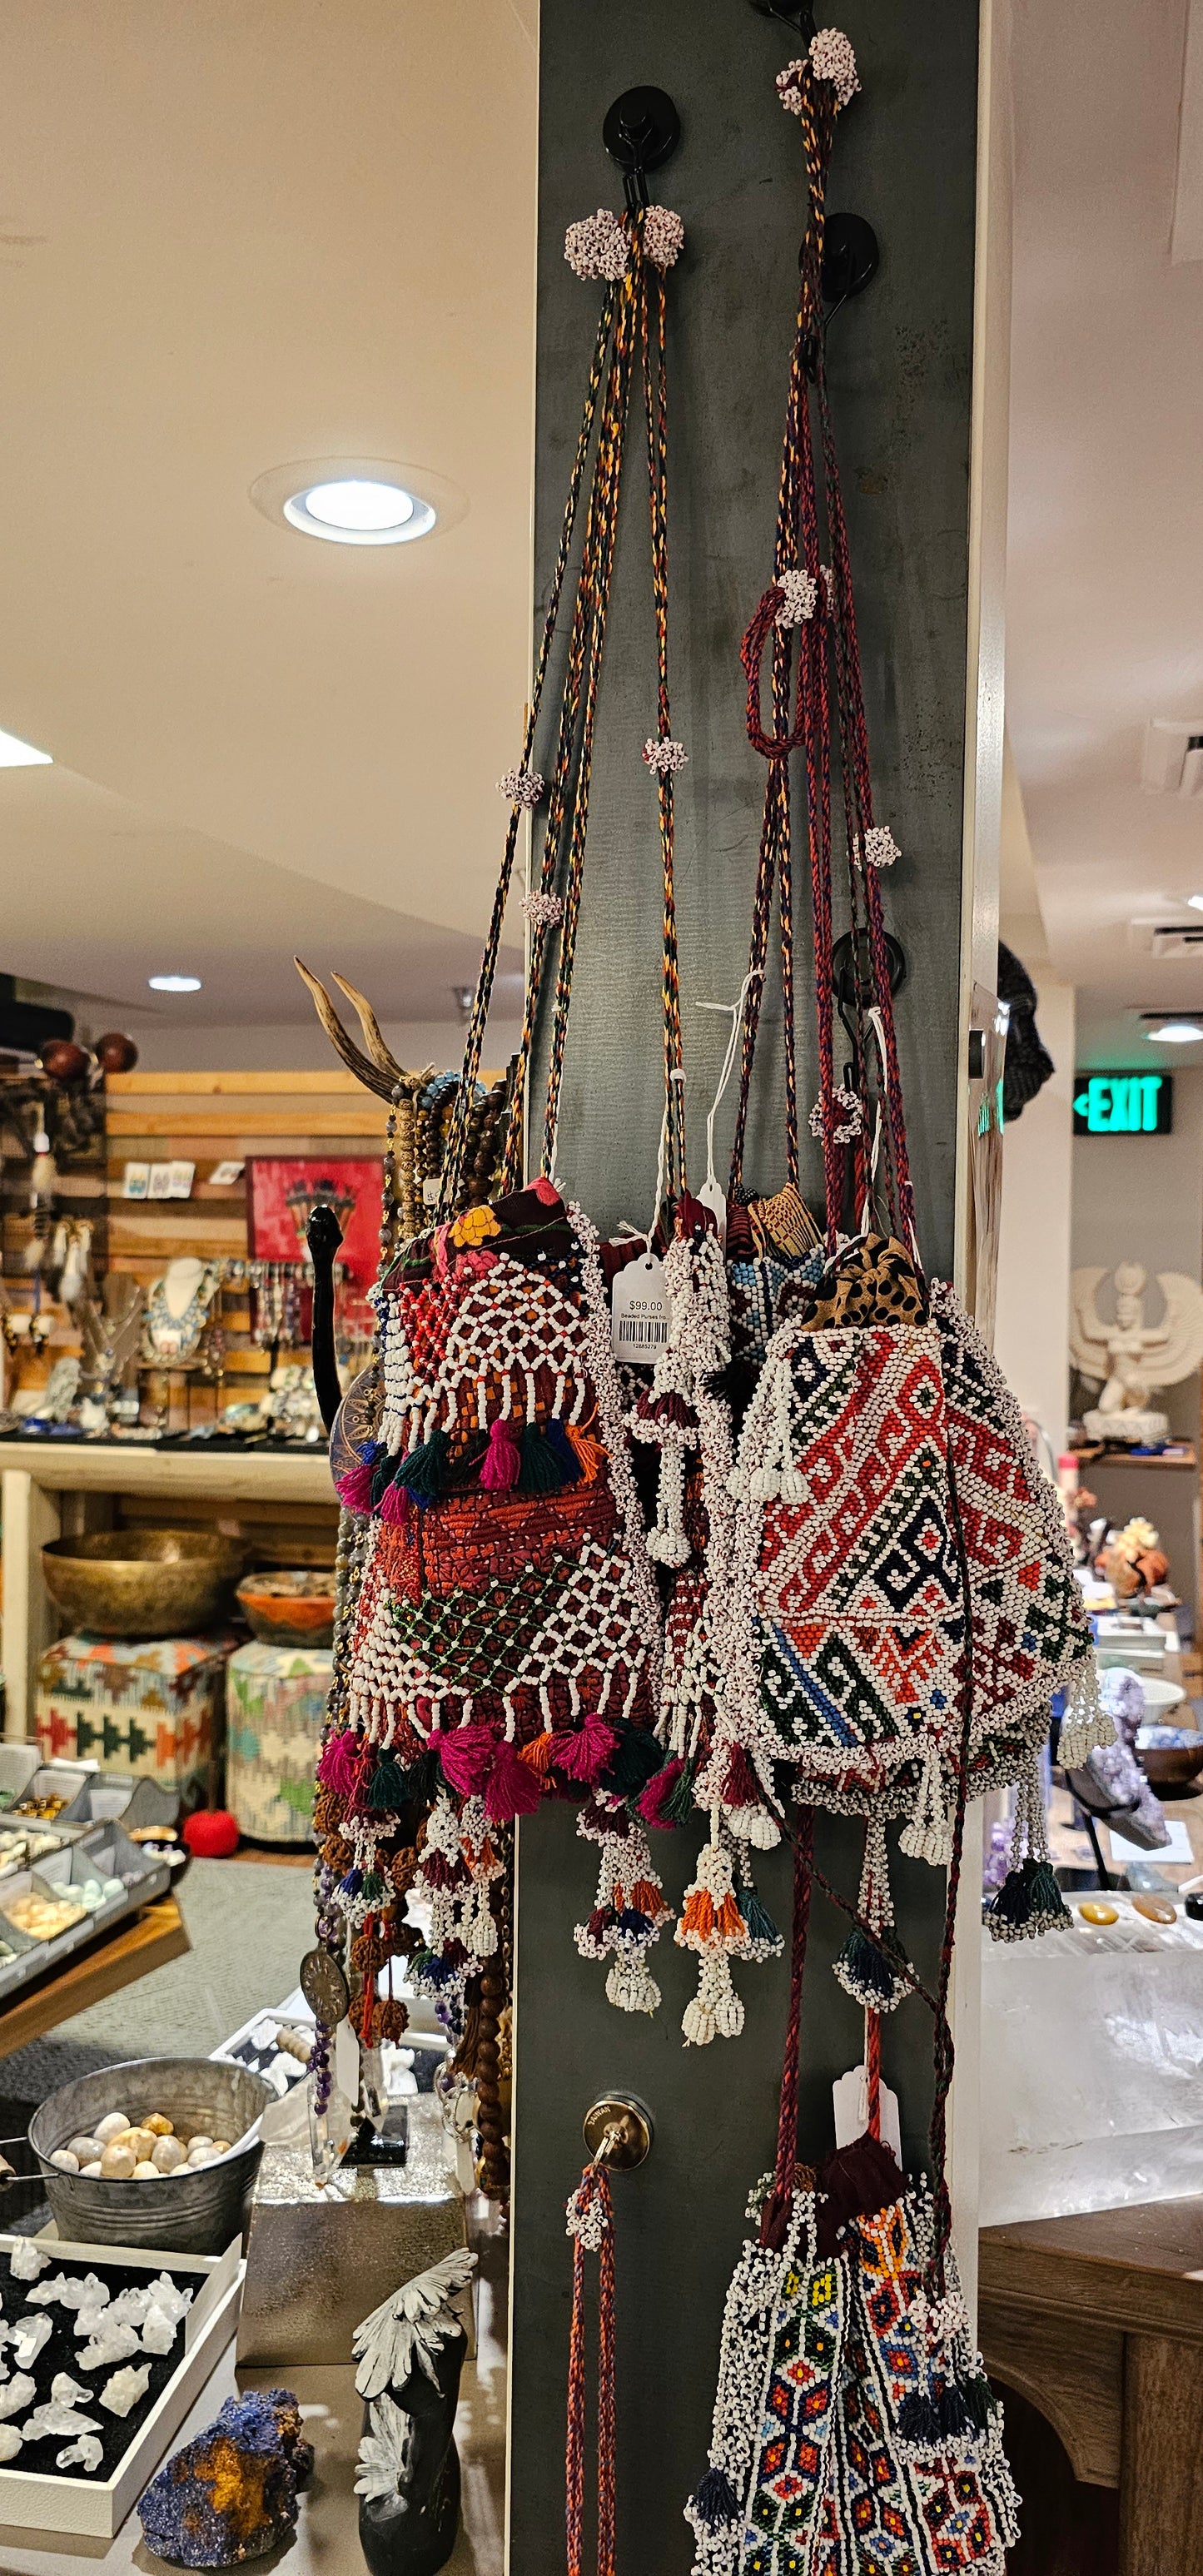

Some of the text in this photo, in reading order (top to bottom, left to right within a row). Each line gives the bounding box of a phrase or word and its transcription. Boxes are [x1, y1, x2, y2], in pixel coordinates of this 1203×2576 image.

[1088, 1077, 1162, 1131] EXIT
[629, 1300, 663, 1310] $99.00
[587, 2106, 611, 2125] TAIWAN
